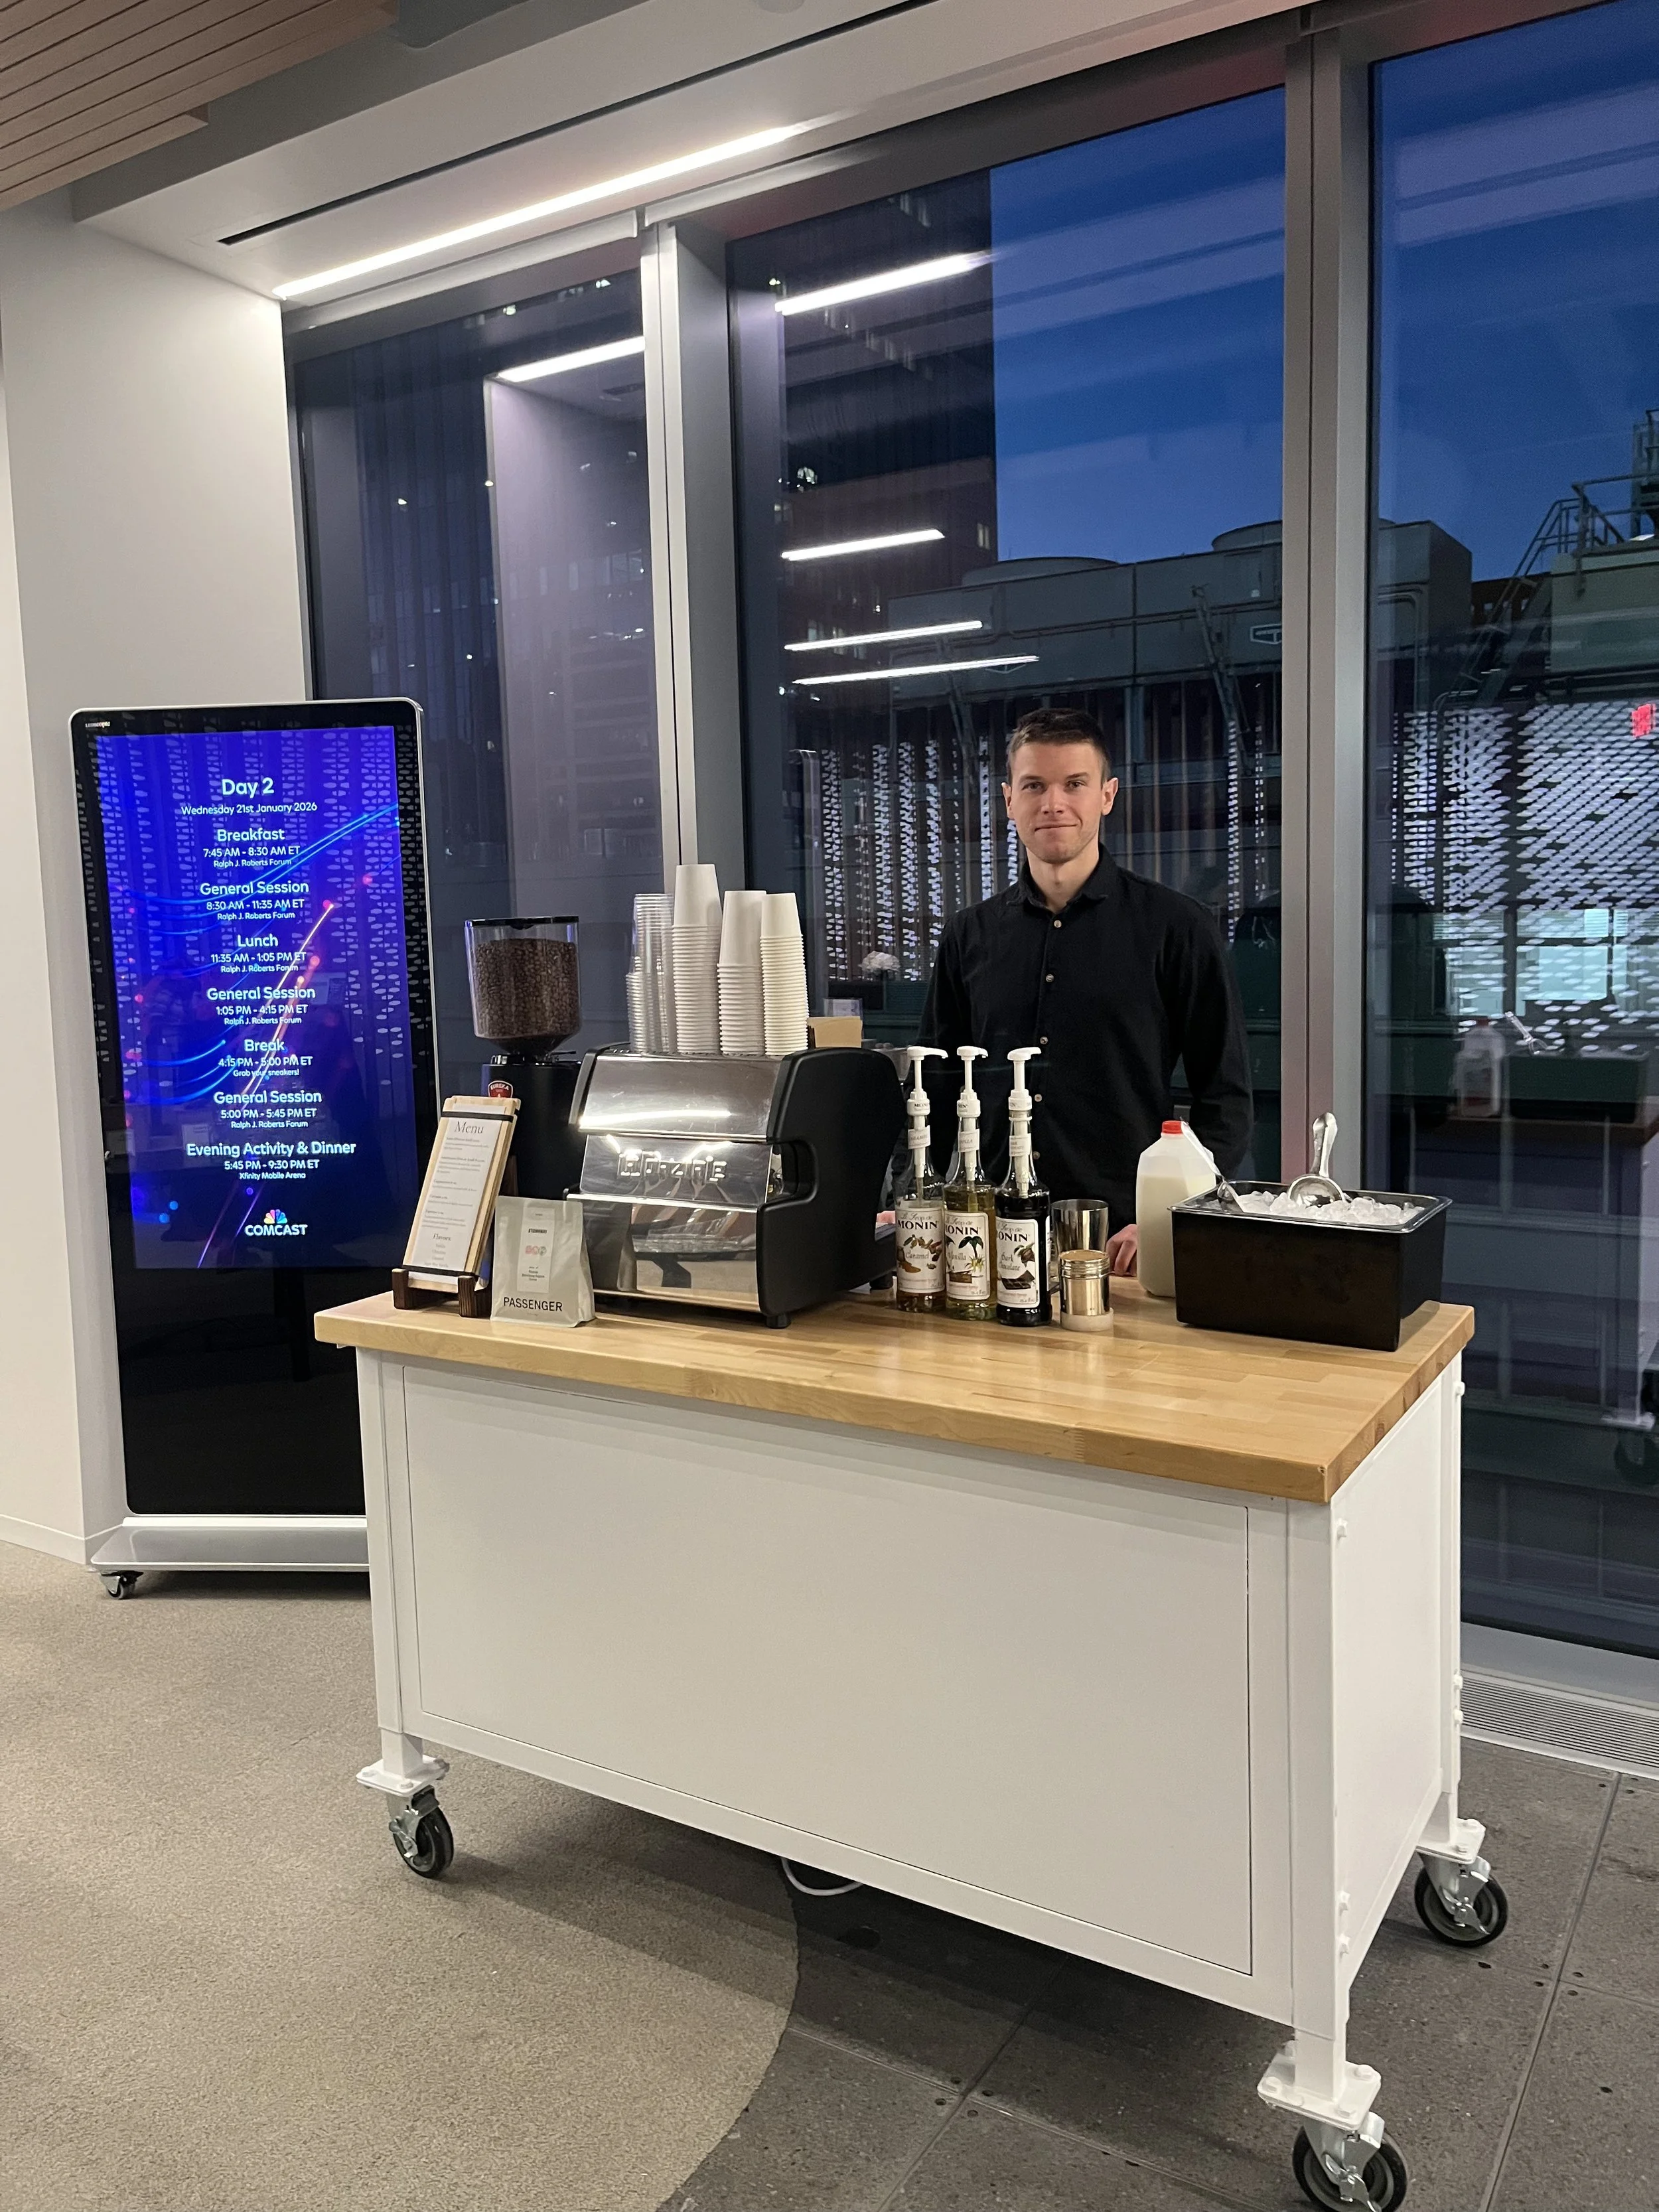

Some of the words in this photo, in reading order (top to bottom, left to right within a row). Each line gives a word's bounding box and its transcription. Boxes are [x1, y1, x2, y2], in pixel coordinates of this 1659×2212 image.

[222, 778, 258, 798] Day
[262, 777, 275, 794] 2
[181, 804, 235, 816] Wednesday
[236, 804, 254, 814] 21st
[255, 804, 293, 814] January
[293, 802, 318, 812] 2026
[217, 827, 285, 842] Breakfast
[203, 848, 222, 857] 7:45
[224, 848, 240, 857] AM
[248, 846, 269, 856] 8:30
[270, 846, 287, 855] AM
[288, 846, 301, 855] ET
[213, 859, 234, 869] Ralph
[200, 881, 254, 895] General
[256, 880, 309, 894] Session
[206, 901, 226, 911] 8:30
[228, 900, 245, 910] AM
[252, 899, 273, 909] 11:35
[274, 899, 291, 909] AM
[292, 899, 305, 909] ET
[217, 913, 237, 921] Ralph
[237, 933, 279, 947] Lunch
[210, 953, 232, 963] 11:35
[233, 953, 250, 962] AM
[256, 952, 275, 962] 1:05
[277, 952, 293, 962] PM
[294, 951, 307, 961] ET
[220, 965, 241, 974] Ralph
[206, 986, 261, 1000] General
[263, 986, 316, 999] Session
[216, 1005, 234, 1015] 1:05
[236, 1005, 252, 1015] PM
[259, 1005, 277, 1014] 4:15
[278, 1004, 294, 1014] PM
[295, 1004, 309, 1013] ET
[244, 1038, 285, 1052] Break
[218, 1057, 236, 1067] 4:15
[238, 1057, 253, 1067] PM
[261, 1057, 281, 1067] 5:00
[283, 1057, 299, 1066] PM
[300, 1056, 313, 1066] ET
[232, 1069, 251, 1077] Grab
[251, 1069, 267, 1078] your
[268, 1068, 300, 1076] sneakers!
[213, 1090, 267, 1104] General
[270, 1089, 323, 1104] Session
[220, 1109, 242, 1119] 5:00
[243, 1109, 259, 1118] PM
[265, 1108, 286, 1118] 5:45
[287, 1108, 304, 1118] PM
[305, 1108, 317, 1118] ET
[230, 1120, 252, 1130] Ralph
[454, 1120, 484, 1134] Menu
[186, 1142, 240, 1158] Evening
[242, 1141, 295, 1157] Activity
[296, 1141, 309, 1154] &
[311, 1141, 356, 1154] Dinner
[224, 1160, 244, 1170] 5:45
[245, 1160, 261, 1169] PM
[268, 1159, 289, 1169] 9:30
[289, 1159, 306, 1169] PM
[307, 1159, 320, 1169] ET
[240, 1172, 261, 1181] Xfinity
[245, 1224, 309, 1236] COMCAST
[898, 1220, 938, 1230] MONIN
[997, 1231, 1028, 1242] ONIN
[905, 1250, 930, 1260] Caramel
[1001, 1252, 1013, 1262] Dark
[503, 1296, 563, 1312] PASSENGER
